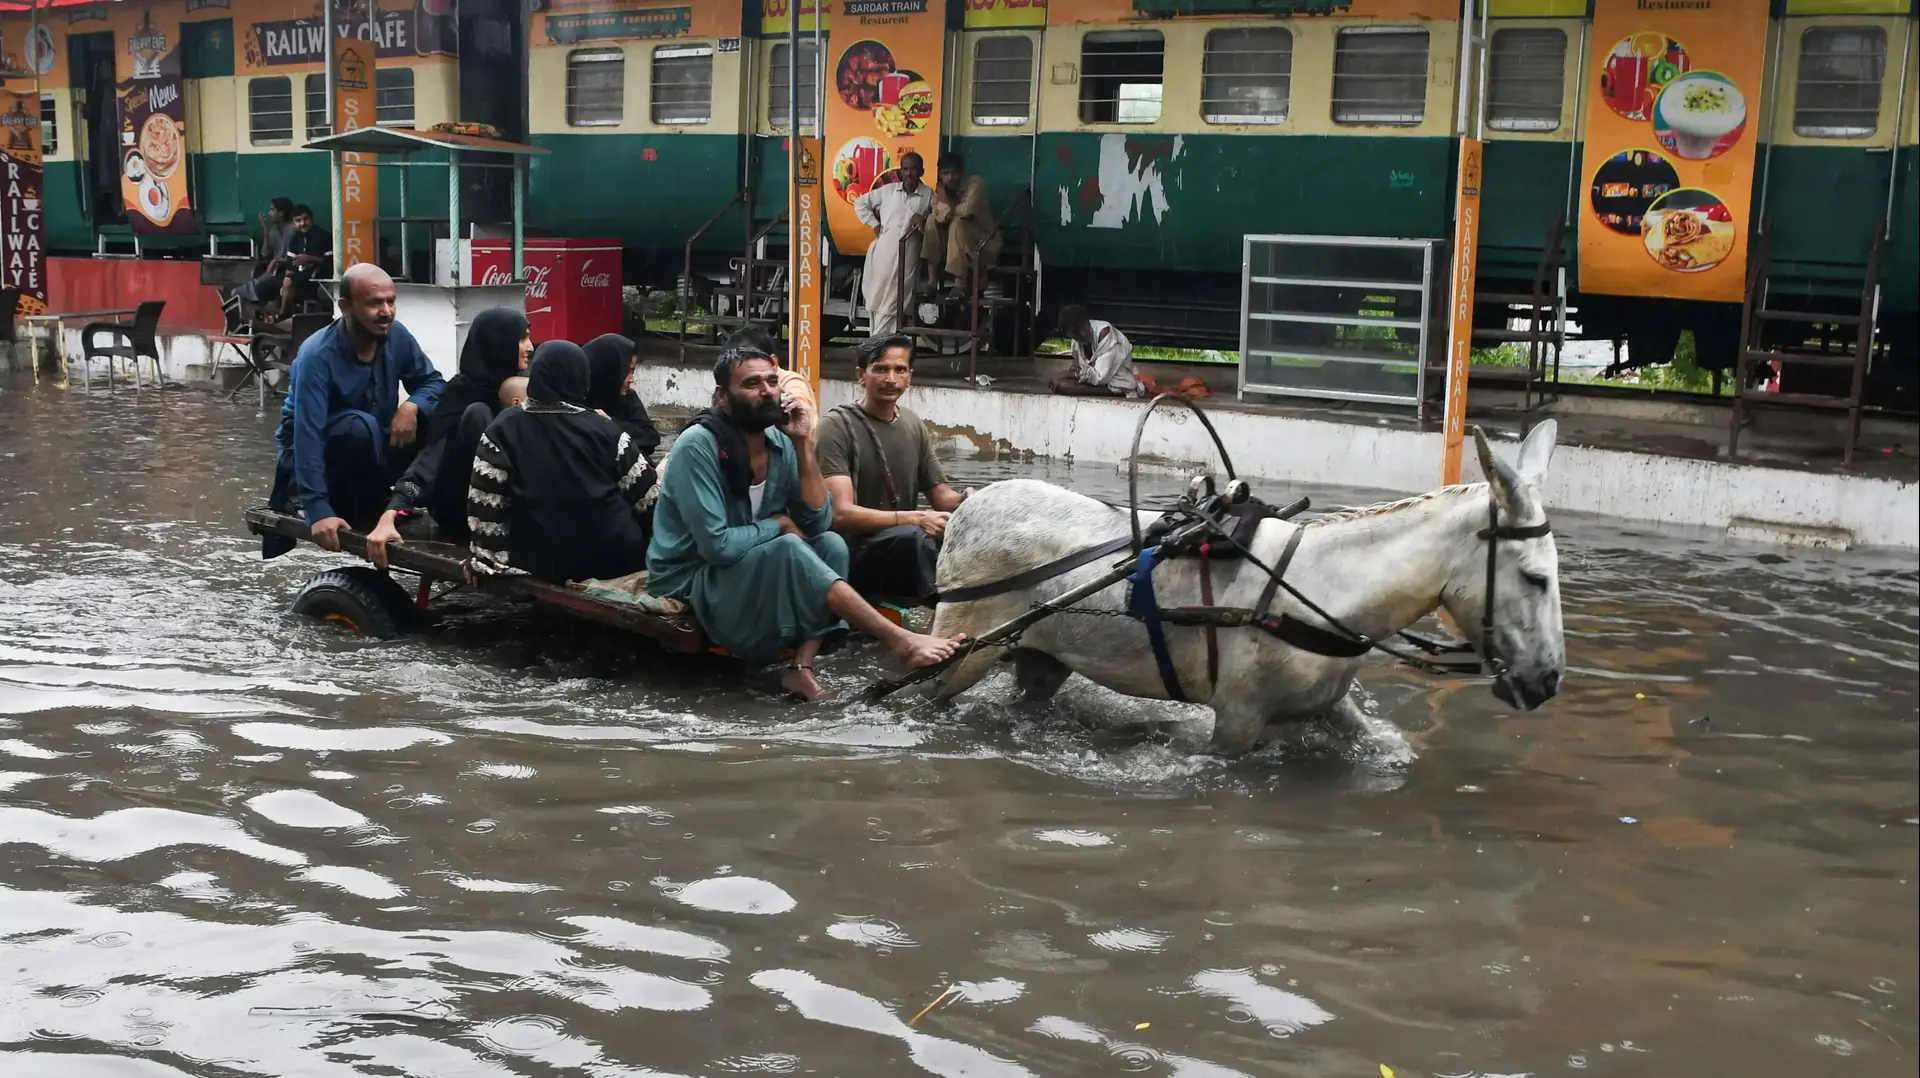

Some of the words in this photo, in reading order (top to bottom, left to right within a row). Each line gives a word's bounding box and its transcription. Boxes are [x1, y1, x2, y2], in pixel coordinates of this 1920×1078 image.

[266, 24, 350, 57] RAILWY
[851, 2, 889, 13] SARDAR
[891, 1, 920, 11] TRAIN
[860, 15, 909, 25] Resturent
[149, 84, 178, 112] Menu
[344, 98, 361, 203] SADAR
[7, 162, 24, 286] RAILWAY
[27, 213, 40, 289] CAFÉ
[347, 220, 361, 269] TRA
[800, 194, 812, 288] SARDAR
[1459, 208, 1473, 320] SARDAR
[800, 304, 812, 380] TRAIN
[1451, 340, 1465, 433] TRAIN
